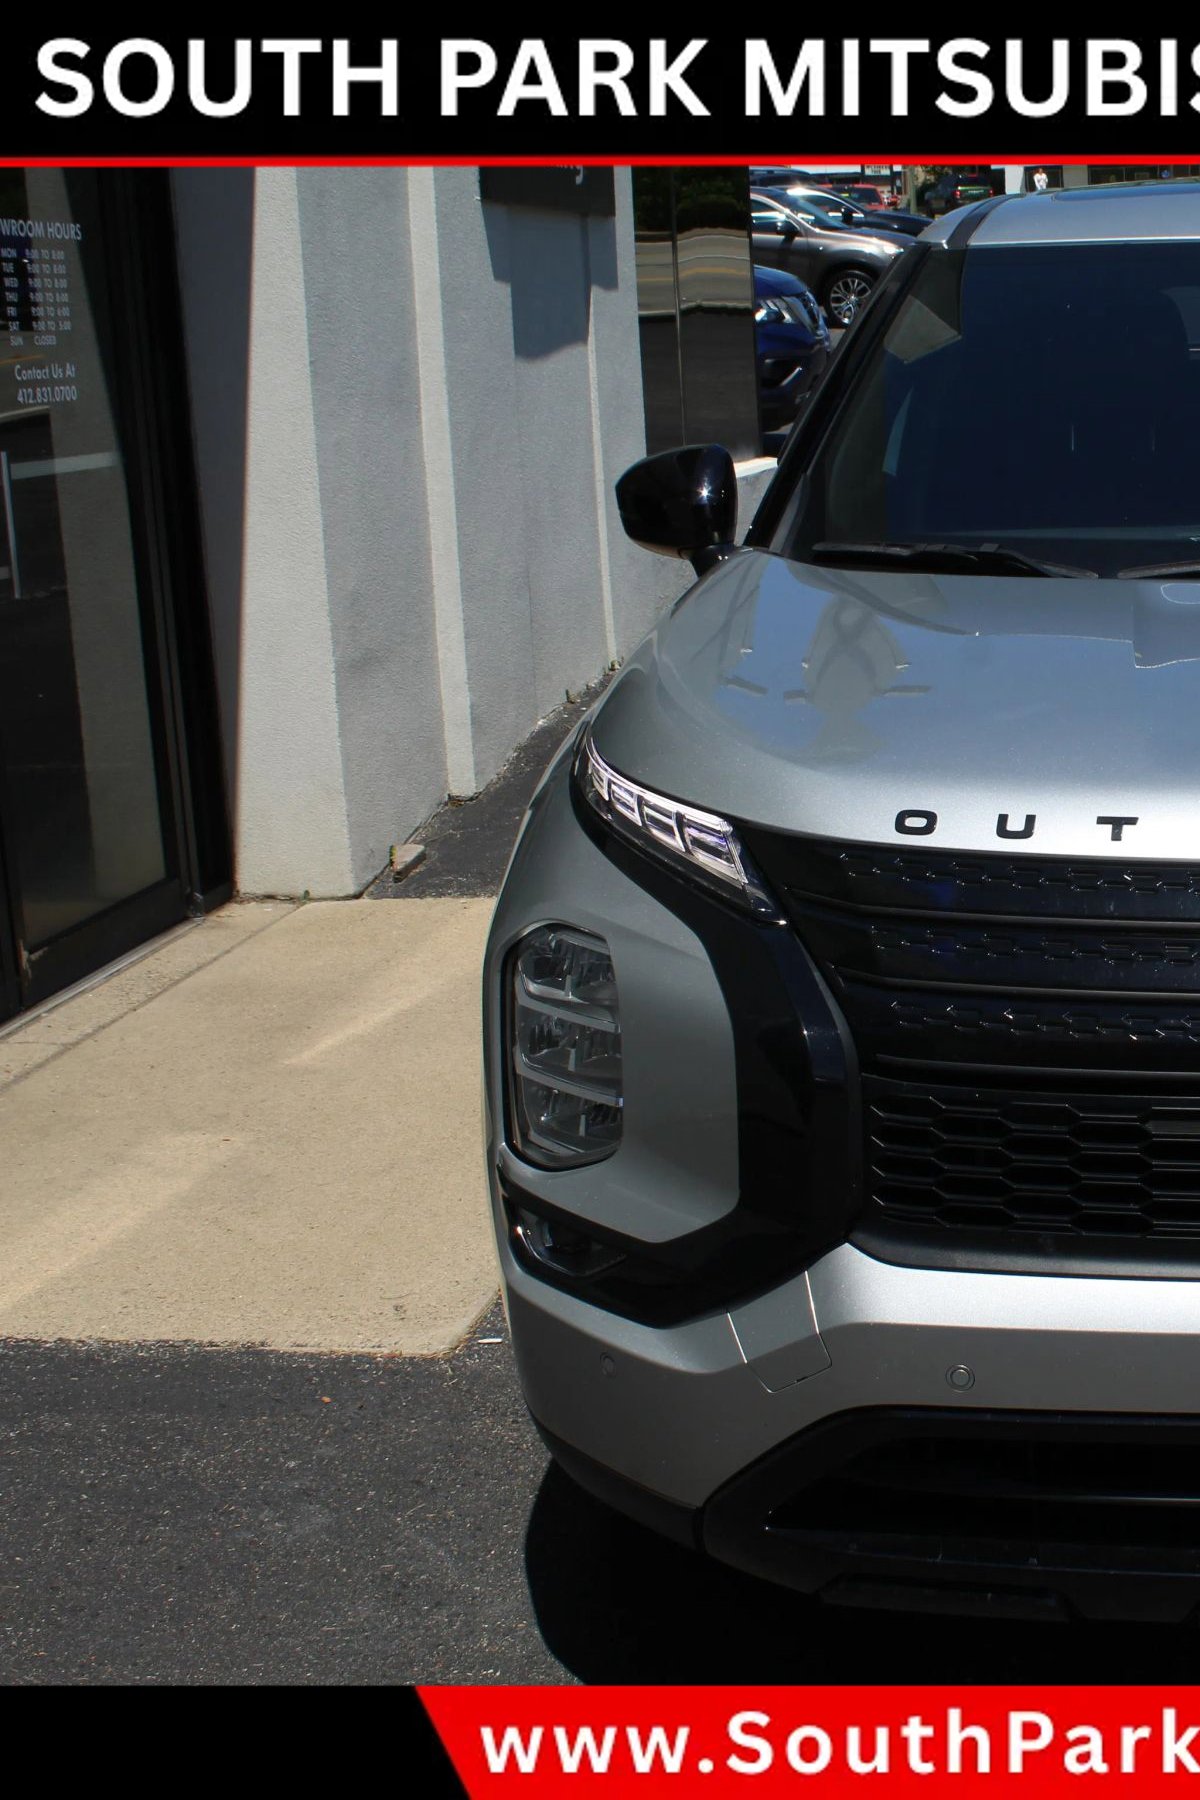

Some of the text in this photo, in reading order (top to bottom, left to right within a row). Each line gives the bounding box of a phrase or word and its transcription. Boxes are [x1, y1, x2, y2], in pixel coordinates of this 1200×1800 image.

[47, 222, 82, 240] HOURS
[34, 335, 57, 345] CLOSED
[15, 362, 76, 381] Contact Us At
[17, 385, 78, 404] 412.831.0700
